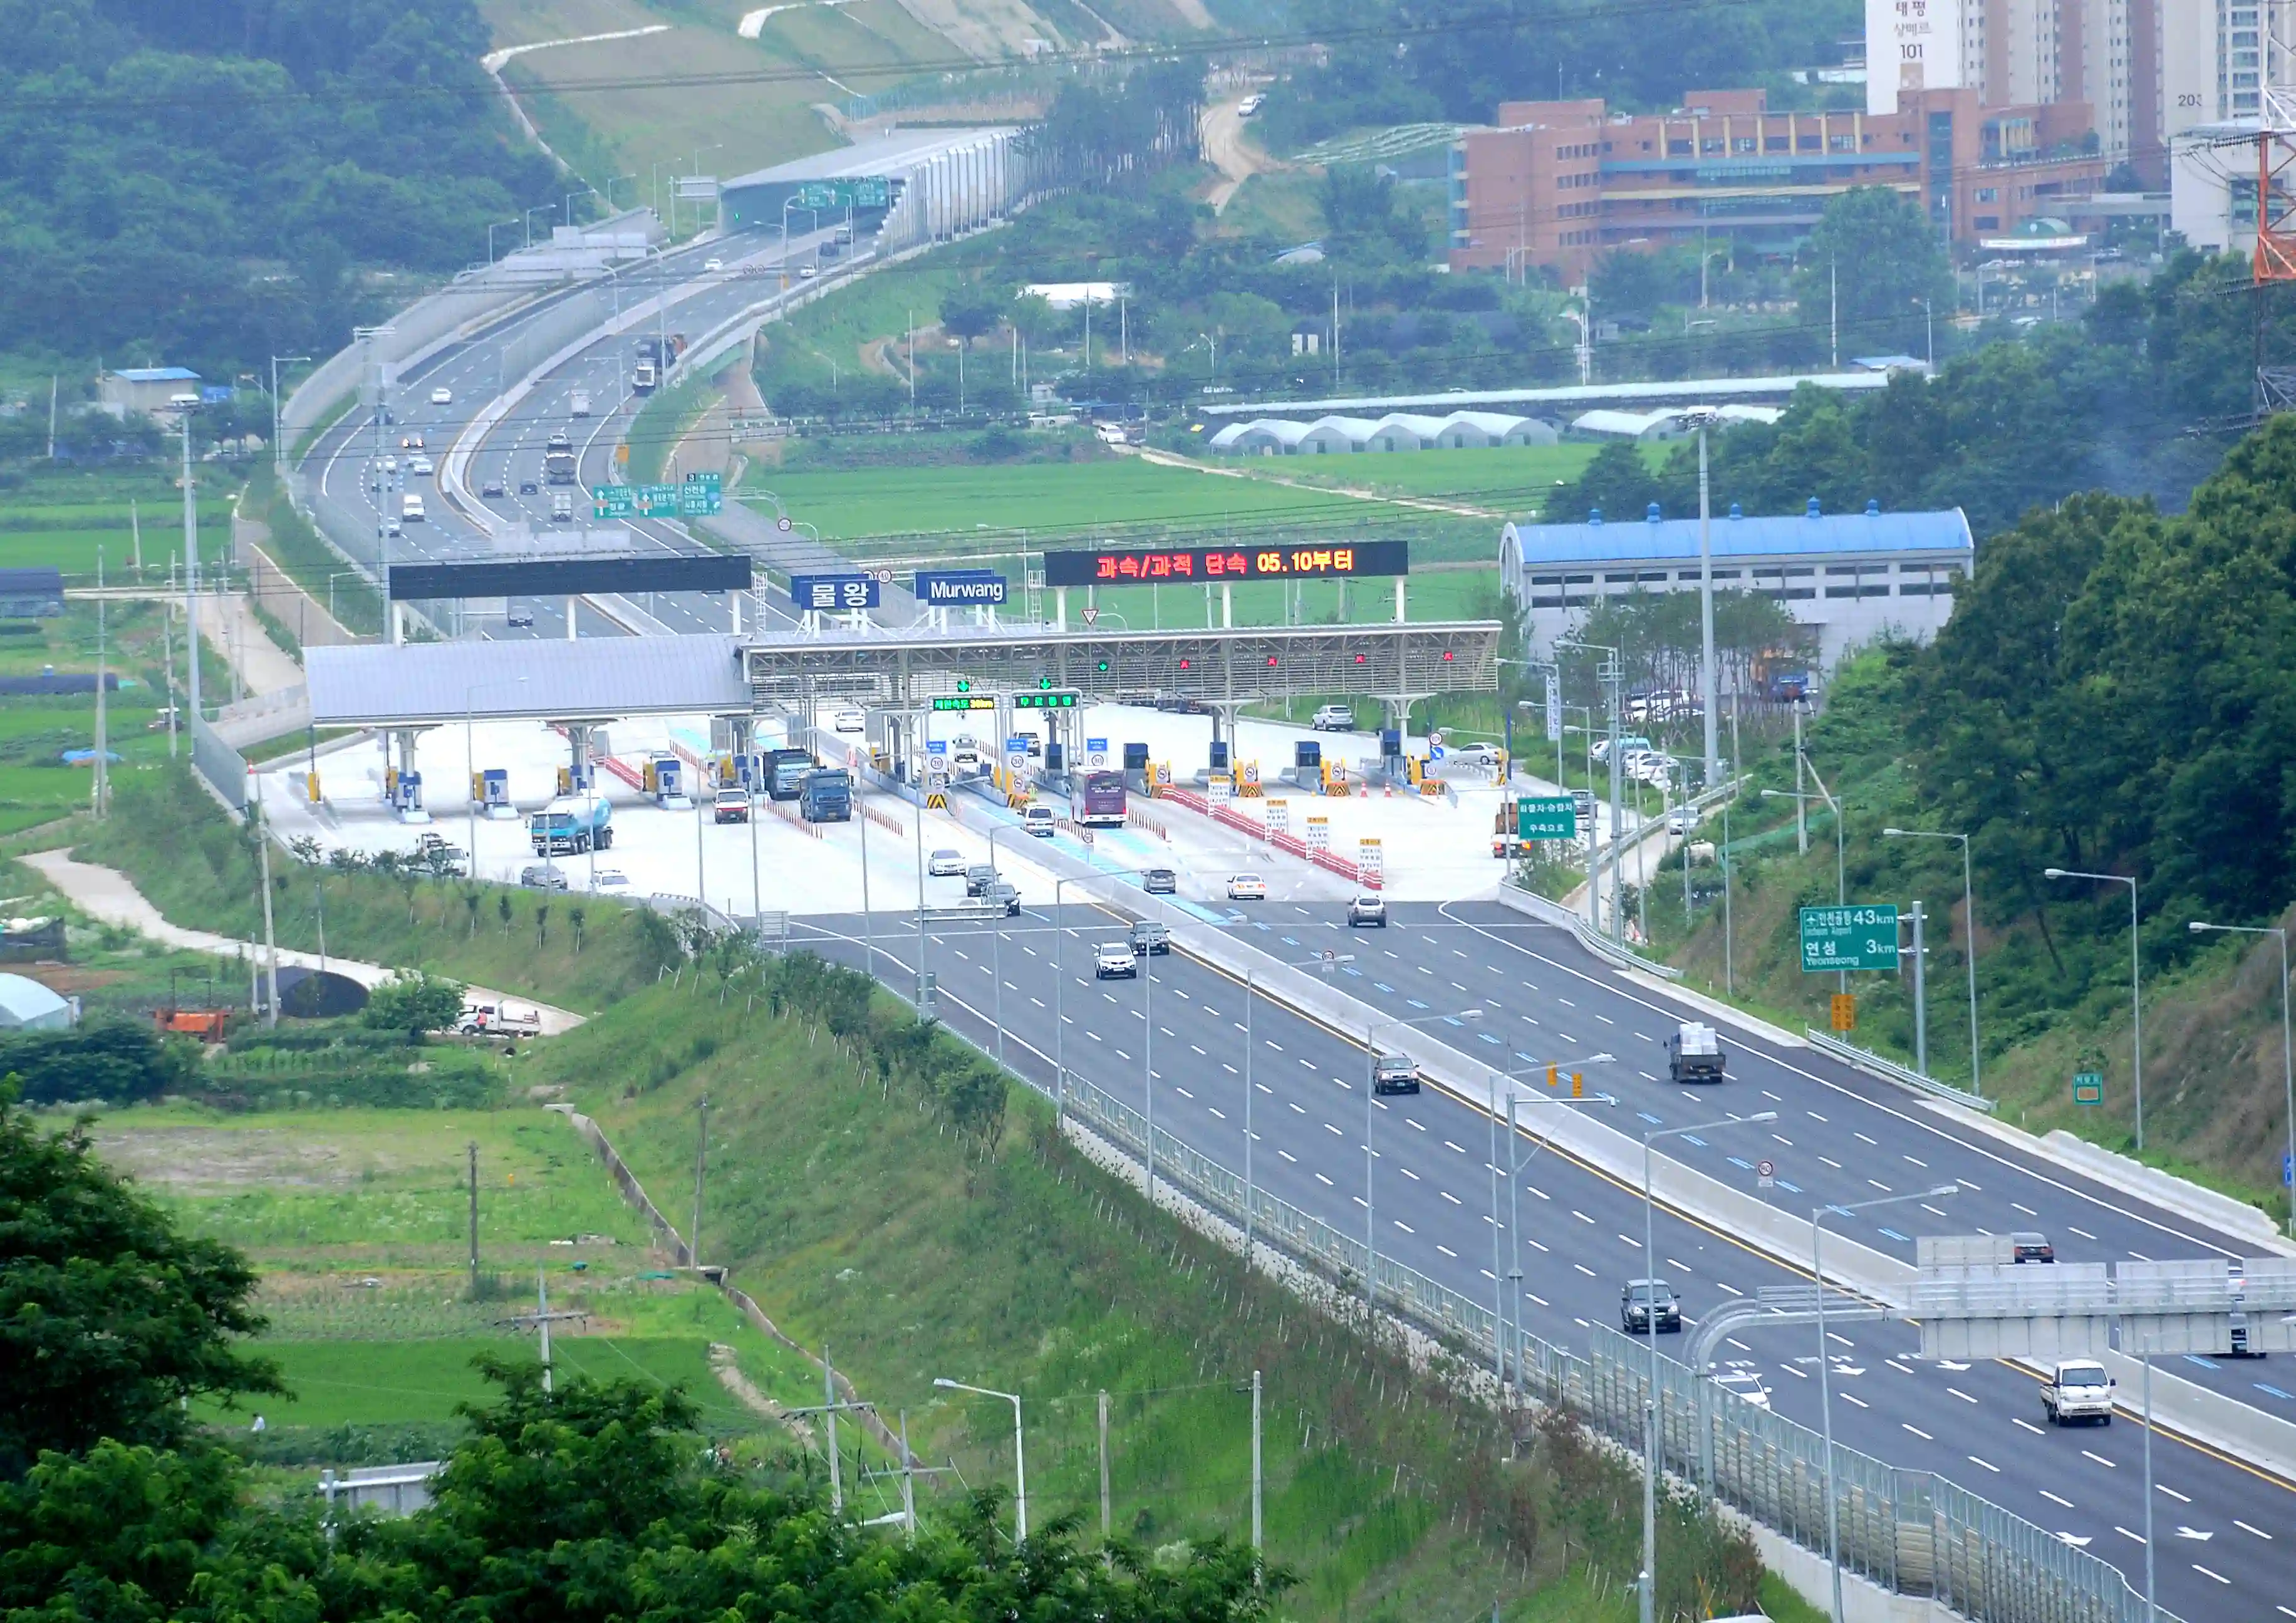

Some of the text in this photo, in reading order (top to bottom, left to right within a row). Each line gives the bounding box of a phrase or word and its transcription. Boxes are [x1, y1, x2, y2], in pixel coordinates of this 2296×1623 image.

[1899, 44, 1923, 59] 101
[1097, 550, 1353, 579] 과속/과적 단속 05.10부터
[931, 581, 1004, 601] Murwang
[1805, 940, 1836, 957] 연성
